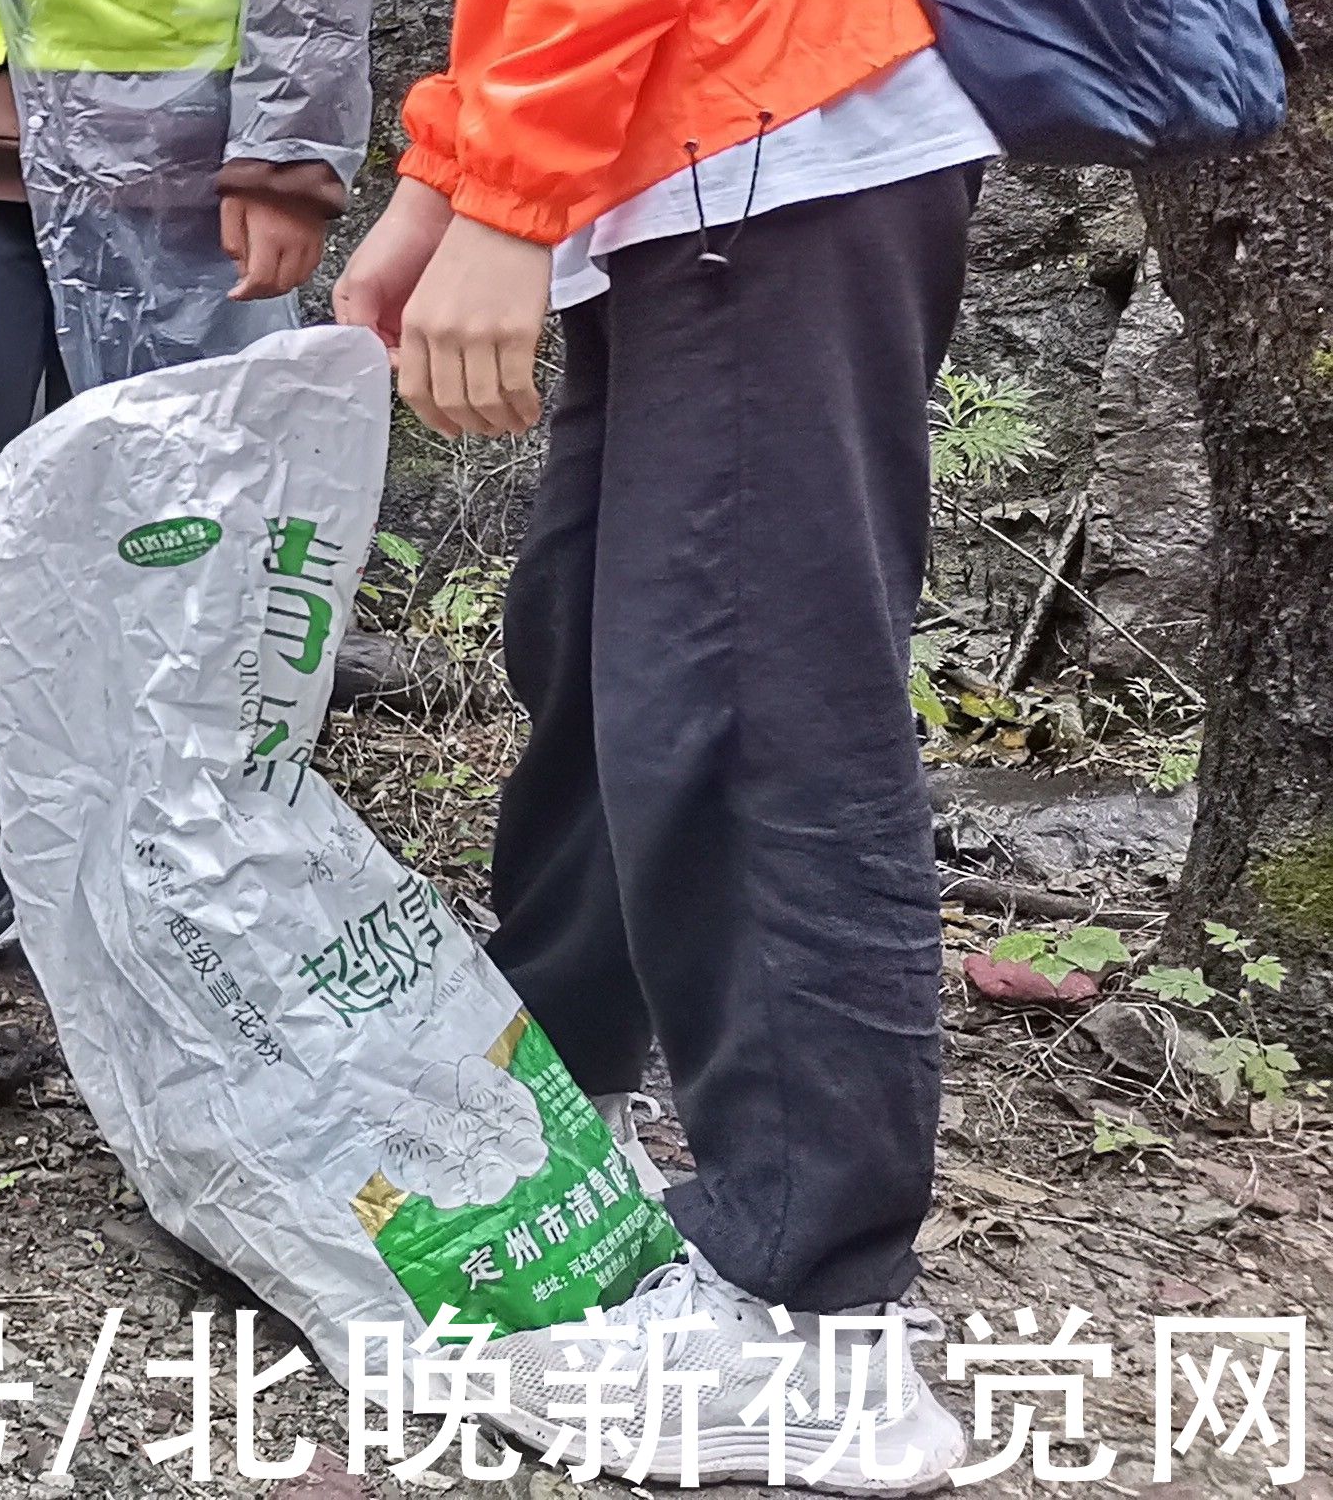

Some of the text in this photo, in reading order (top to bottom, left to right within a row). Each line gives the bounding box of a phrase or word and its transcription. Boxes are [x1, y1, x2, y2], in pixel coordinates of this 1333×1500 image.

[163, 911, 283, 1067] 超级雪花粉
